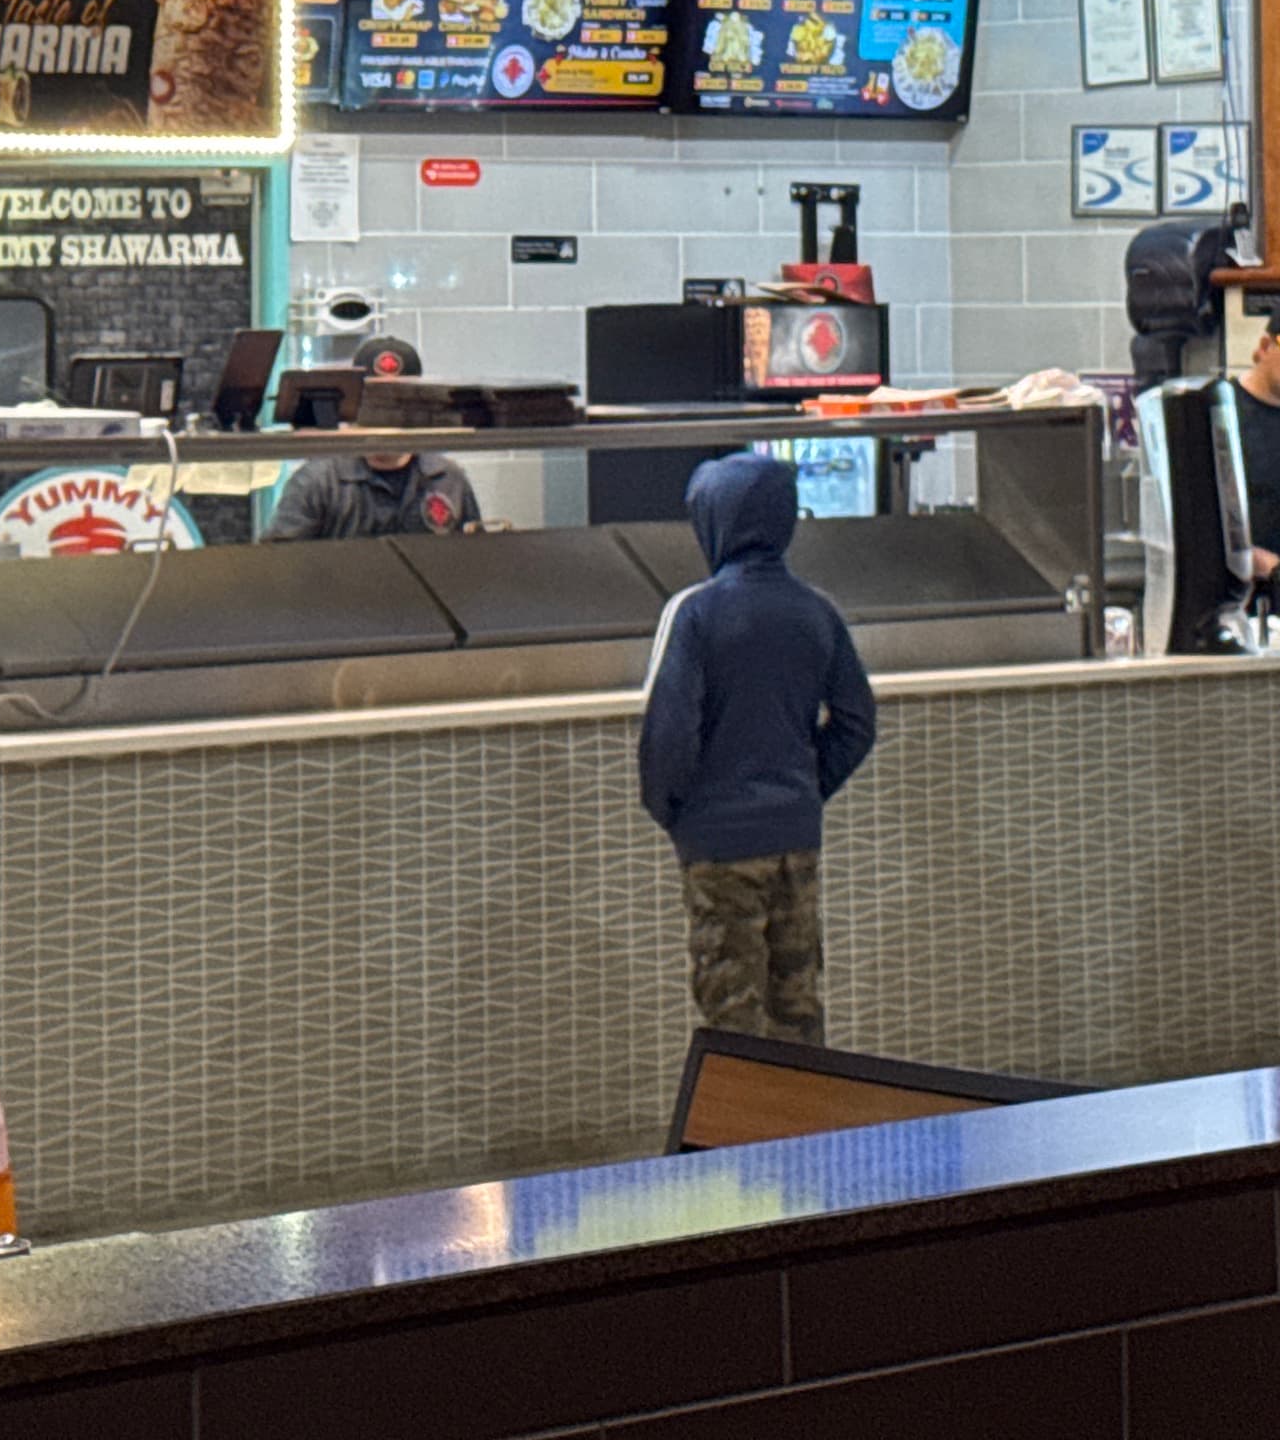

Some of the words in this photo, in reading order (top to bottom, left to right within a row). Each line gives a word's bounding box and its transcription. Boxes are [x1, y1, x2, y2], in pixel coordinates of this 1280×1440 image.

[147, 187, 192, 220] TO
[60, 232, 244, 266] SHAWARMA
[4, 478, 169, 526] YUMMY
